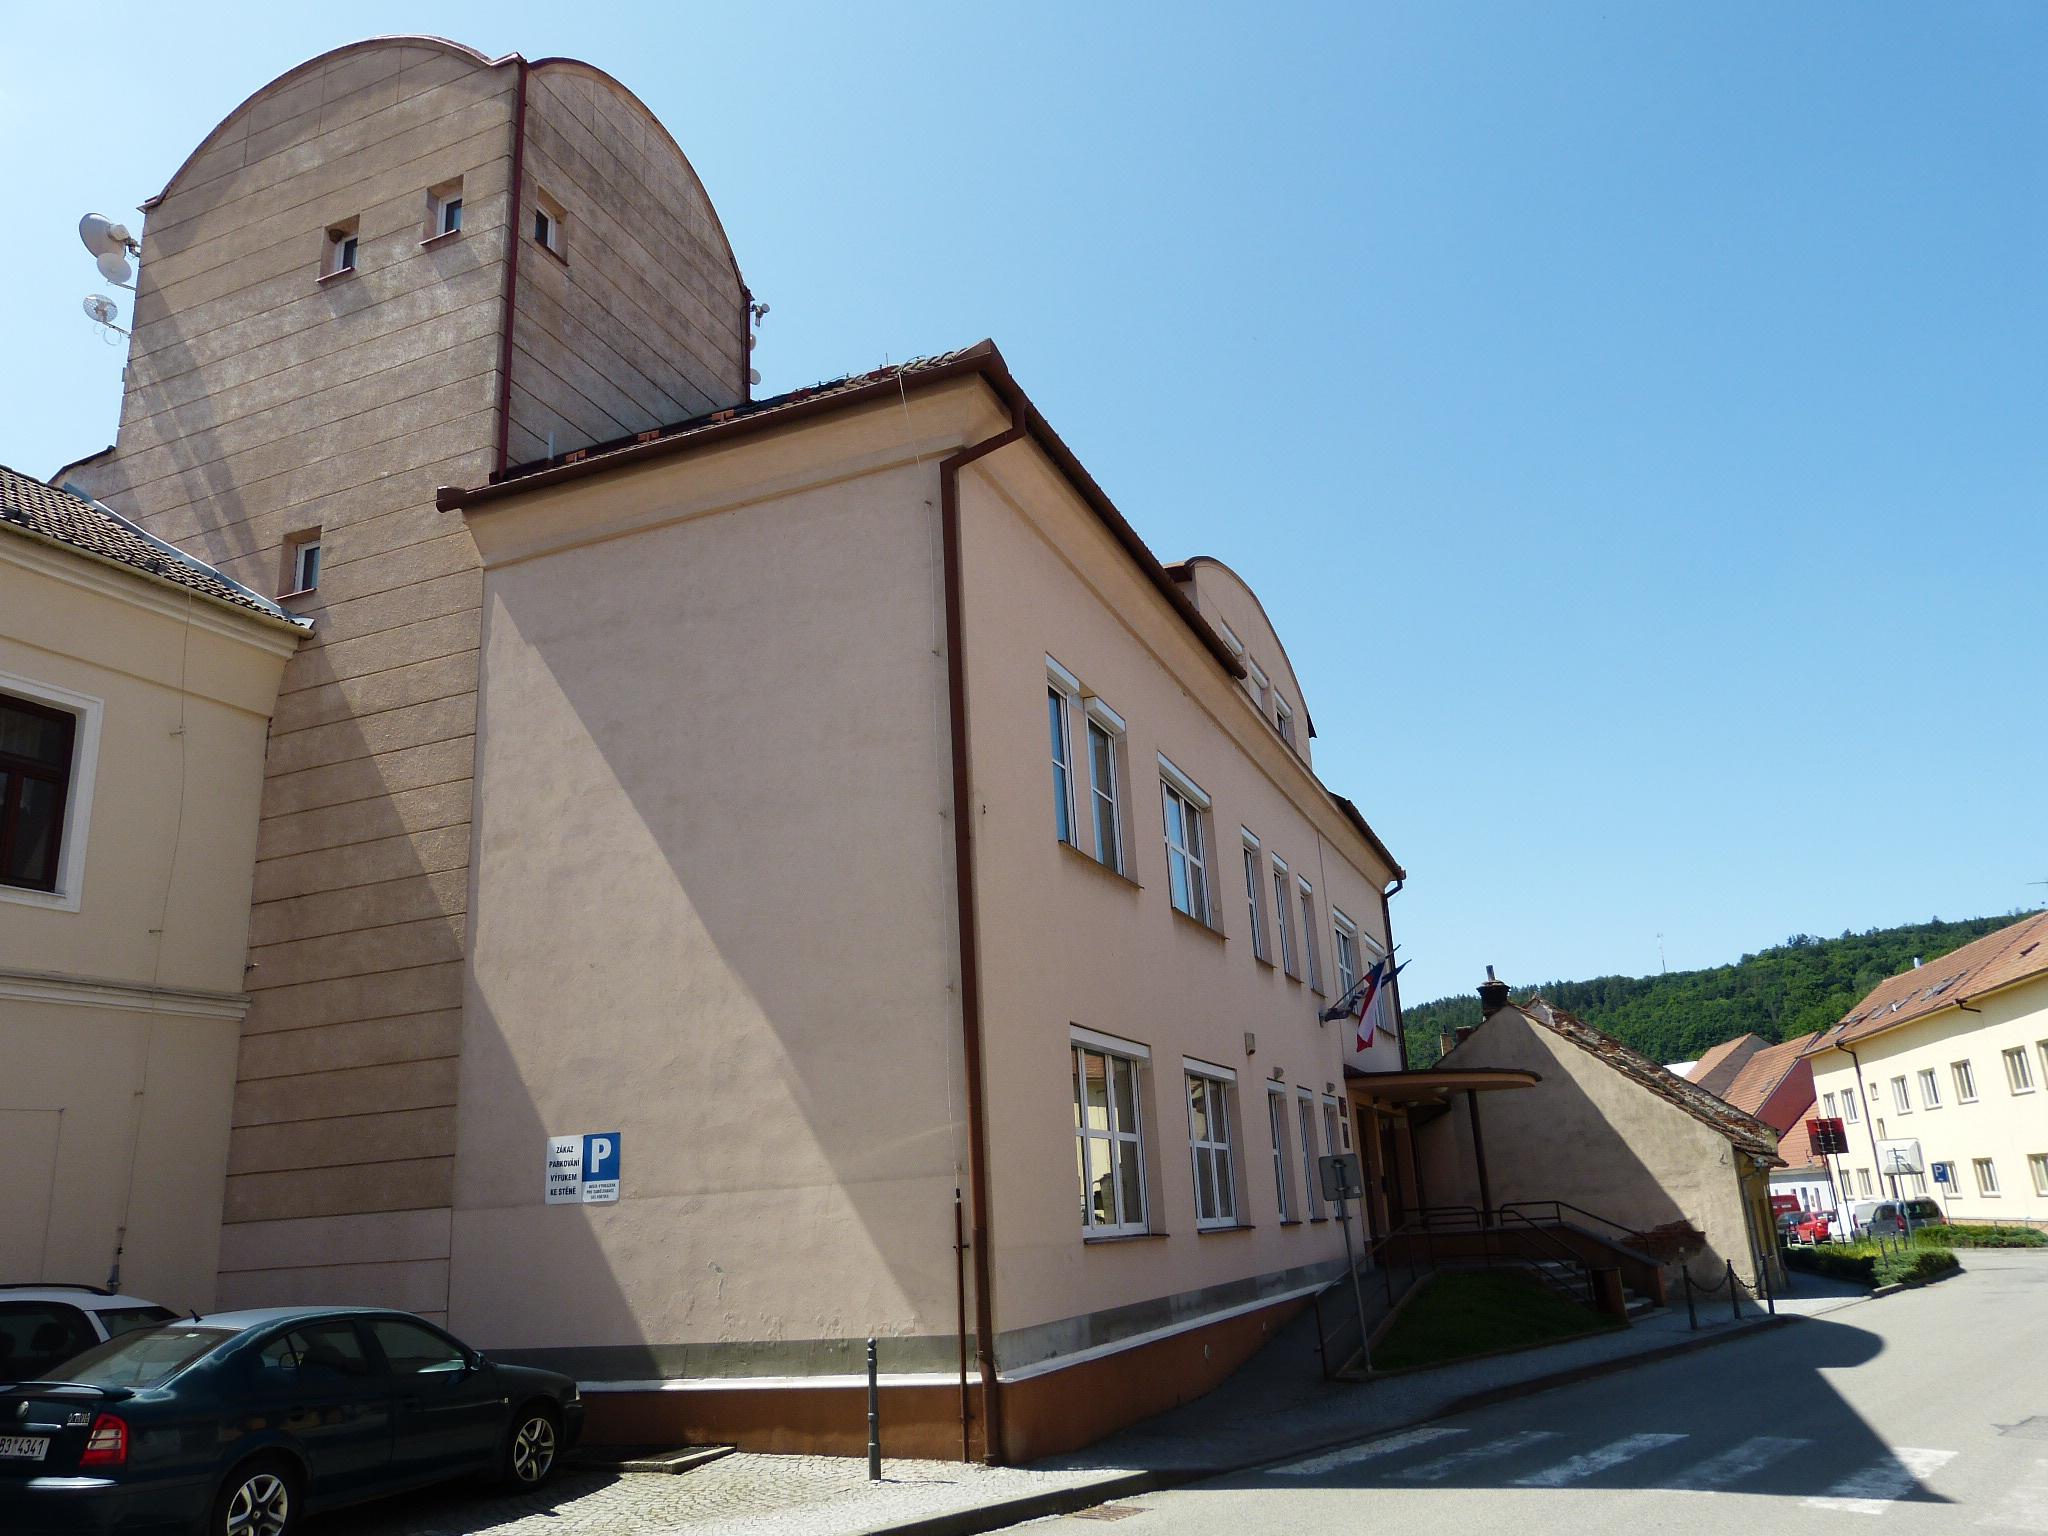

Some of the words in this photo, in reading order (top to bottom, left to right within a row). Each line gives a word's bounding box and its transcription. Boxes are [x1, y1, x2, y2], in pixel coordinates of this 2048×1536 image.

[556, 1145, 574, 1154] ZÁKAZ
[591, 1138, 612, 1173] P
[549, 1158, 580, 1168] PARKOVÁNÍ
[1935, 1165, 1943, 1176] P
[550, 1173, 577, 1182] VÝFUKEM
[17, 1439, 45, 1455] 4341
